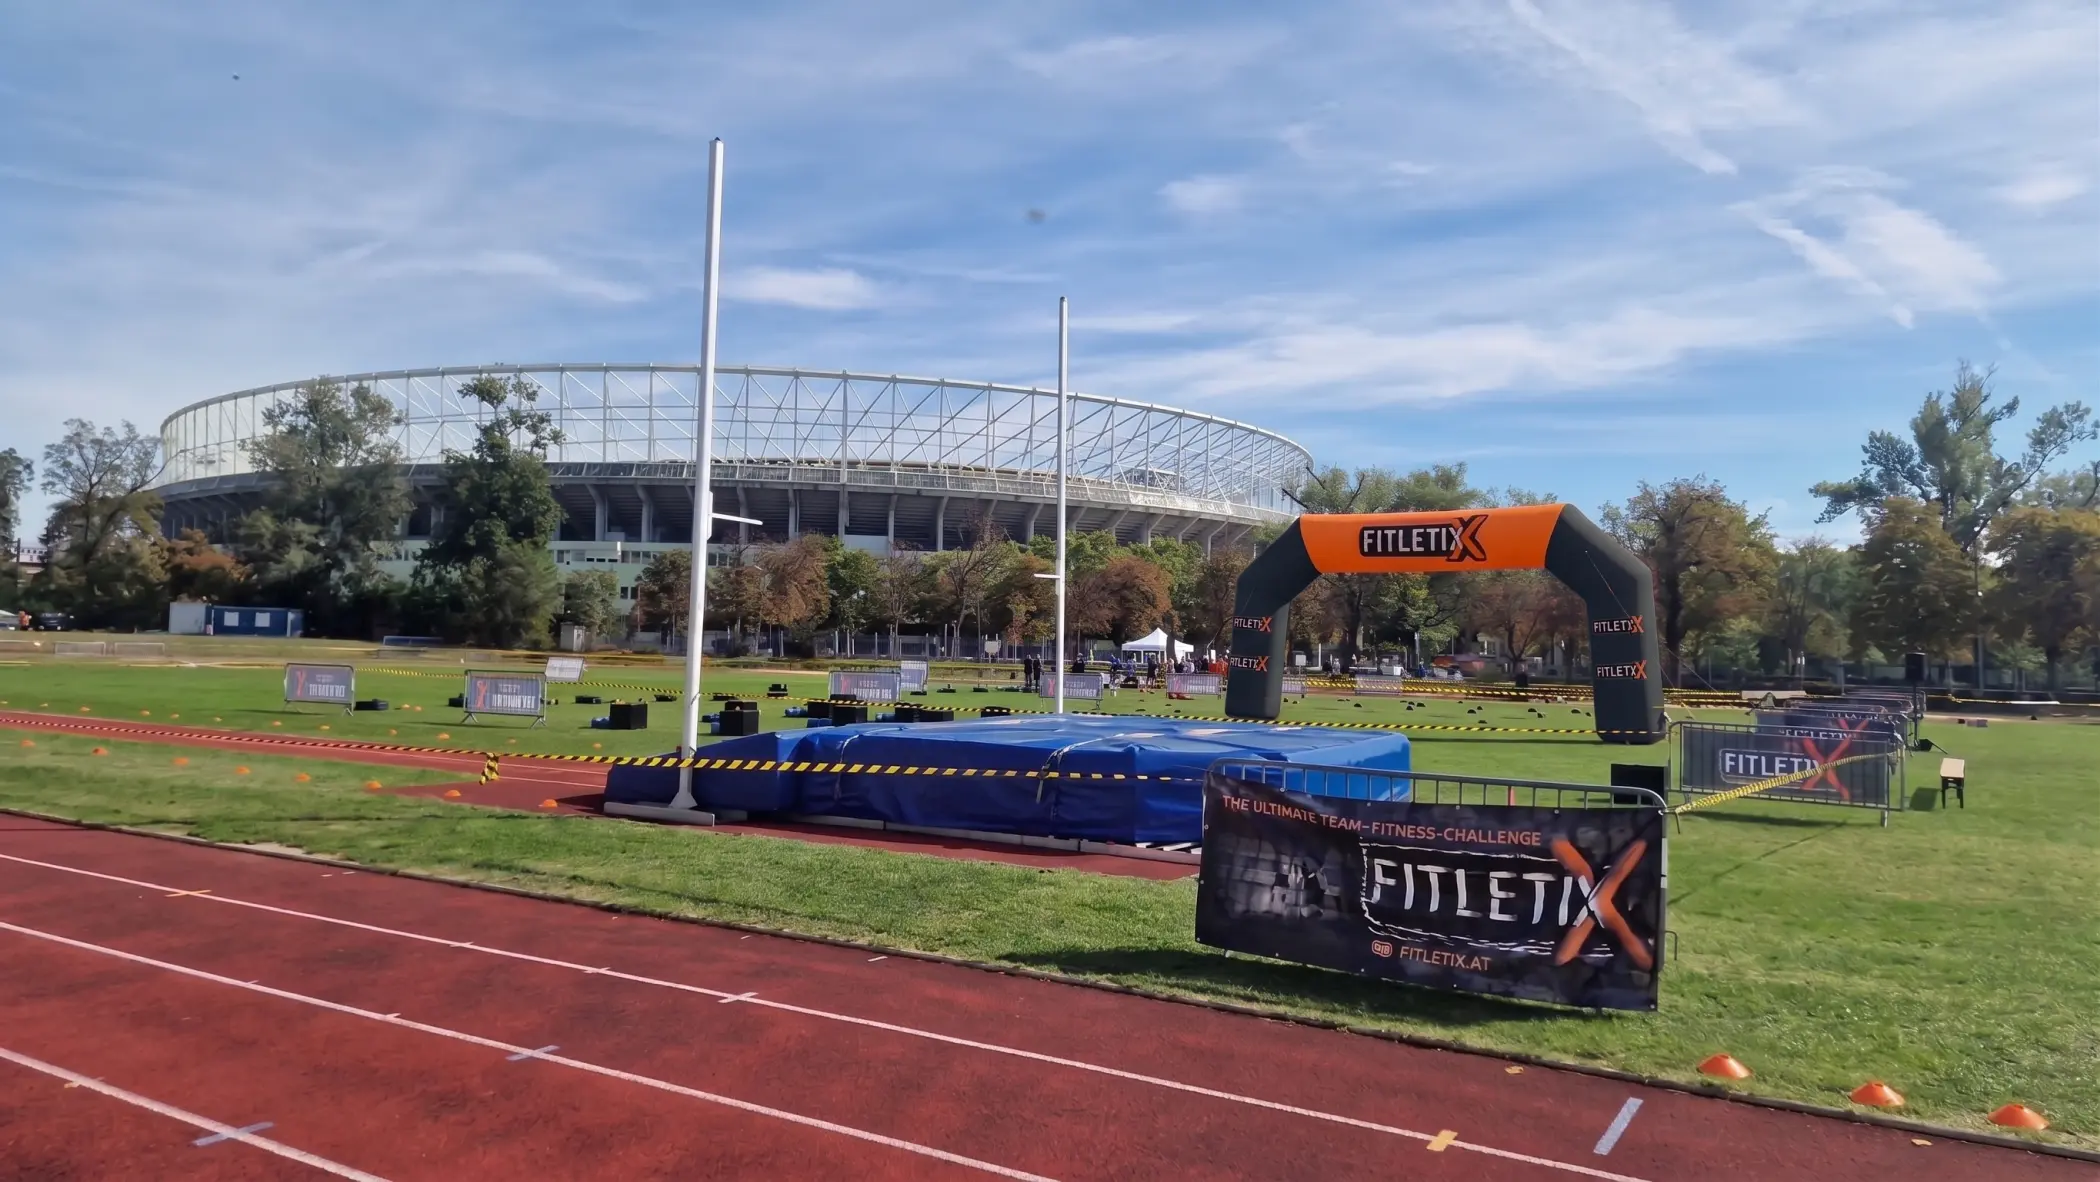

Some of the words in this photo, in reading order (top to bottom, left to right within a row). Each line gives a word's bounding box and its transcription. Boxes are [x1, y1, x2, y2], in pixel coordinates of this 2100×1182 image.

[1363, 514, 1489, 562] FITLETIX
[1222, 794, 1250, 812] THE
[1253, 800, 1317, 824] ULTIMATE
[1371, 838, 1653, 971] FITLETIX
[1400, 946, 1493, 971] FITLETIX.AT
